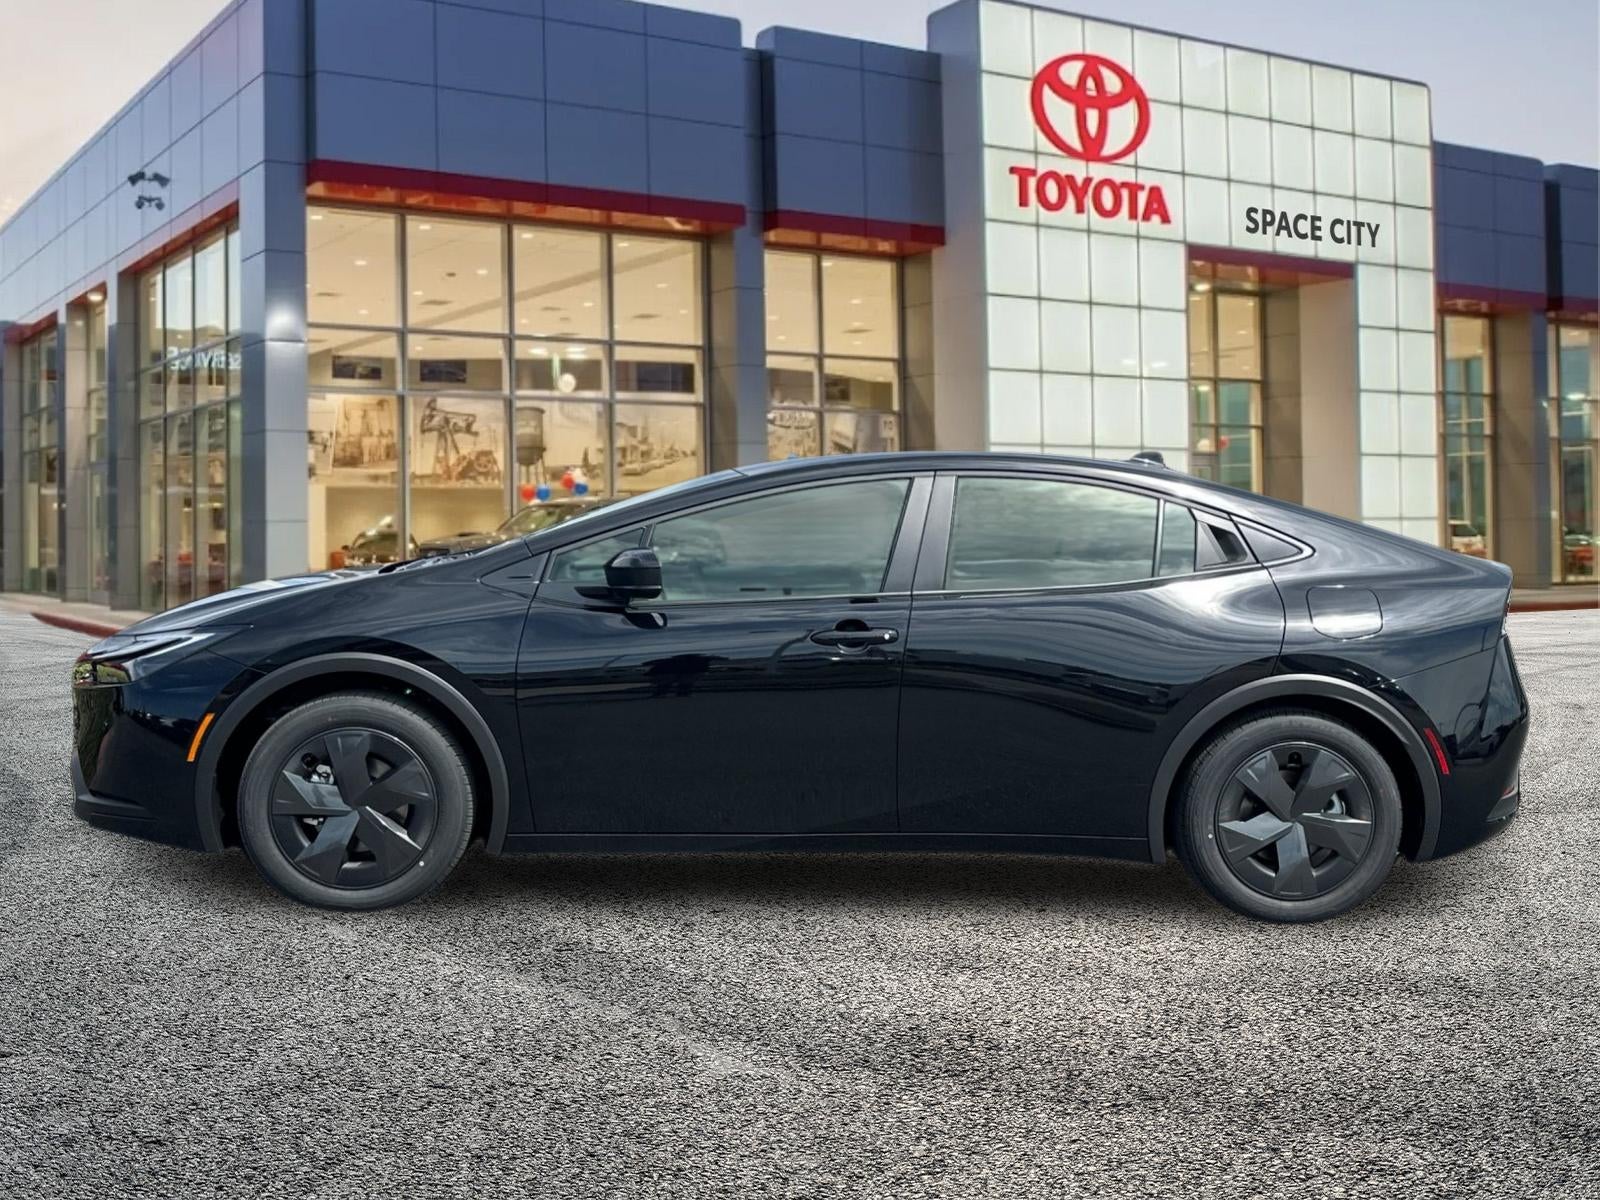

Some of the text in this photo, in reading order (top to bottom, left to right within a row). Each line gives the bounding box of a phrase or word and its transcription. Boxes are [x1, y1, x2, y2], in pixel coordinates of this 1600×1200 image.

[1009, 166, 1171, 224] TOYOTA
[1245, 206, 1380, 248] SPACE CITY
